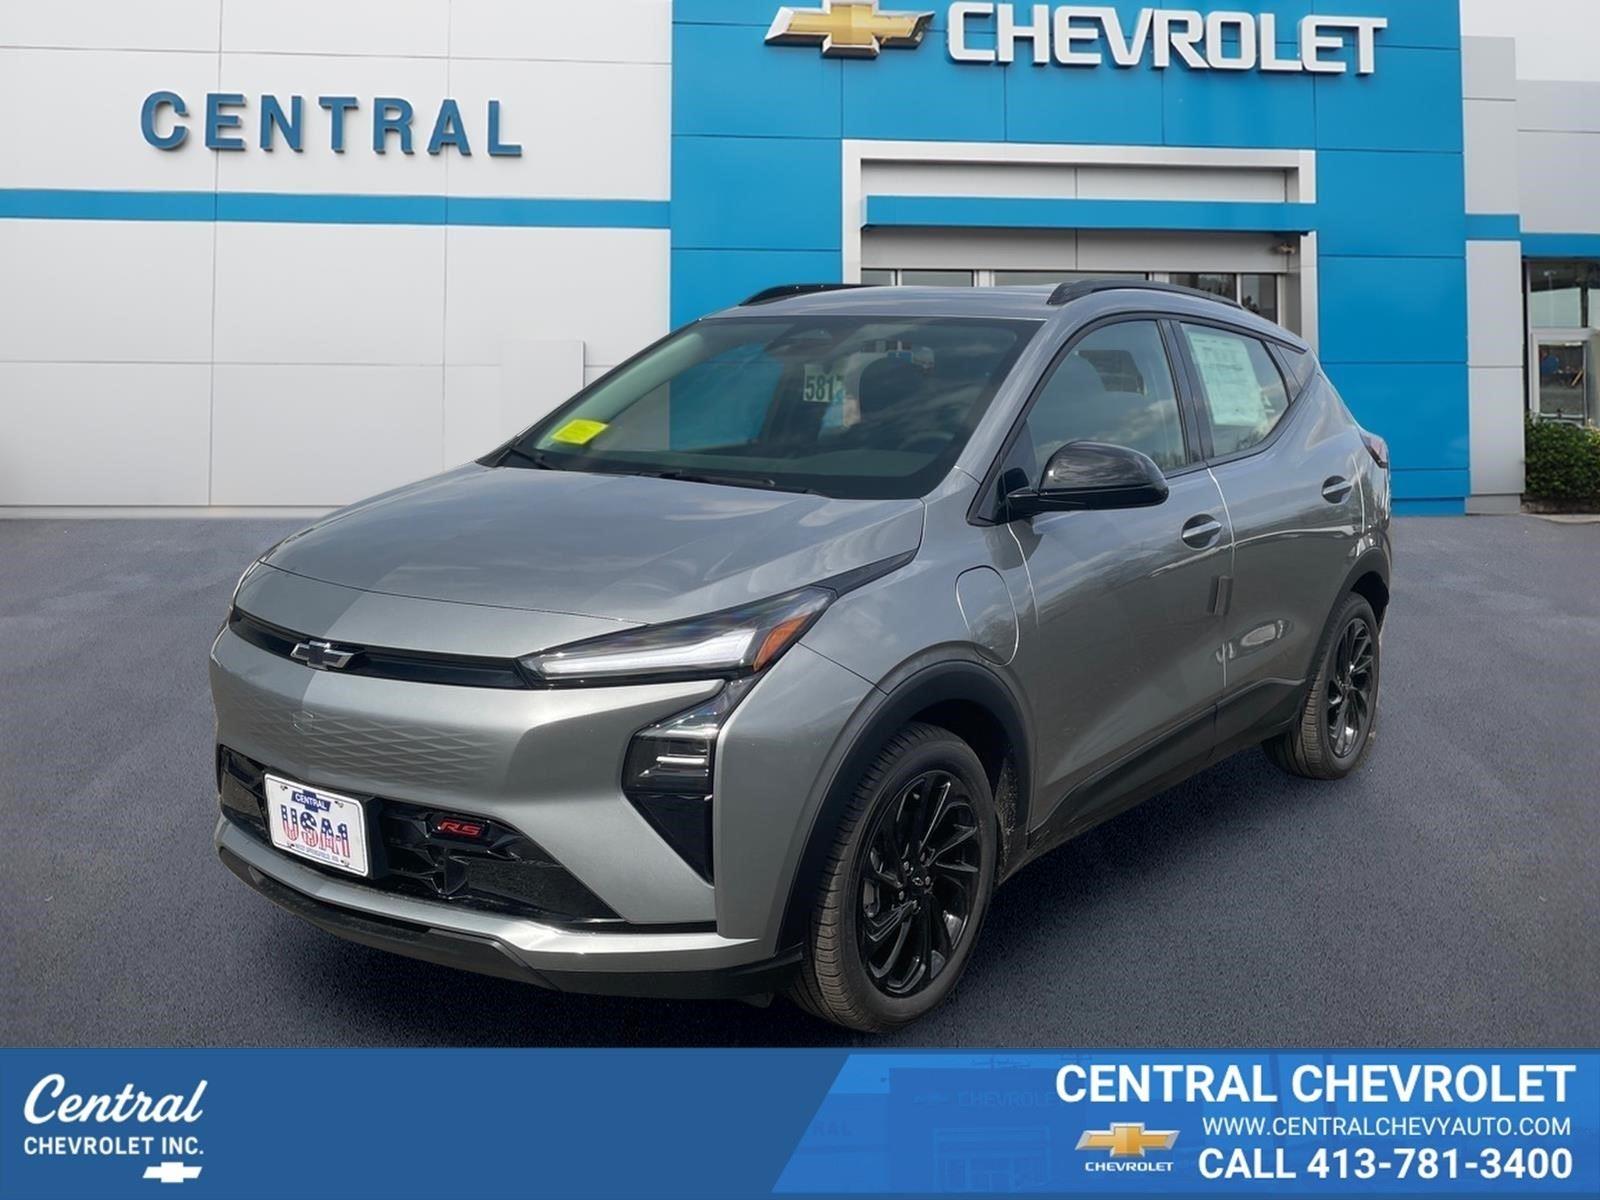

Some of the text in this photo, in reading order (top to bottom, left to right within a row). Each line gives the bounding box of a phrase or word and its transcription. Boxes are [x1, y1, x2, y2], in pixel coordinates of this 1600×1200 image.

[947, 1, 1388, 76] CHEVROLET
[140, 90, 523, 158] CENTRAL
[294, 793, 328, 811] CENTRAL
[439, 820, 482, 837] RS
